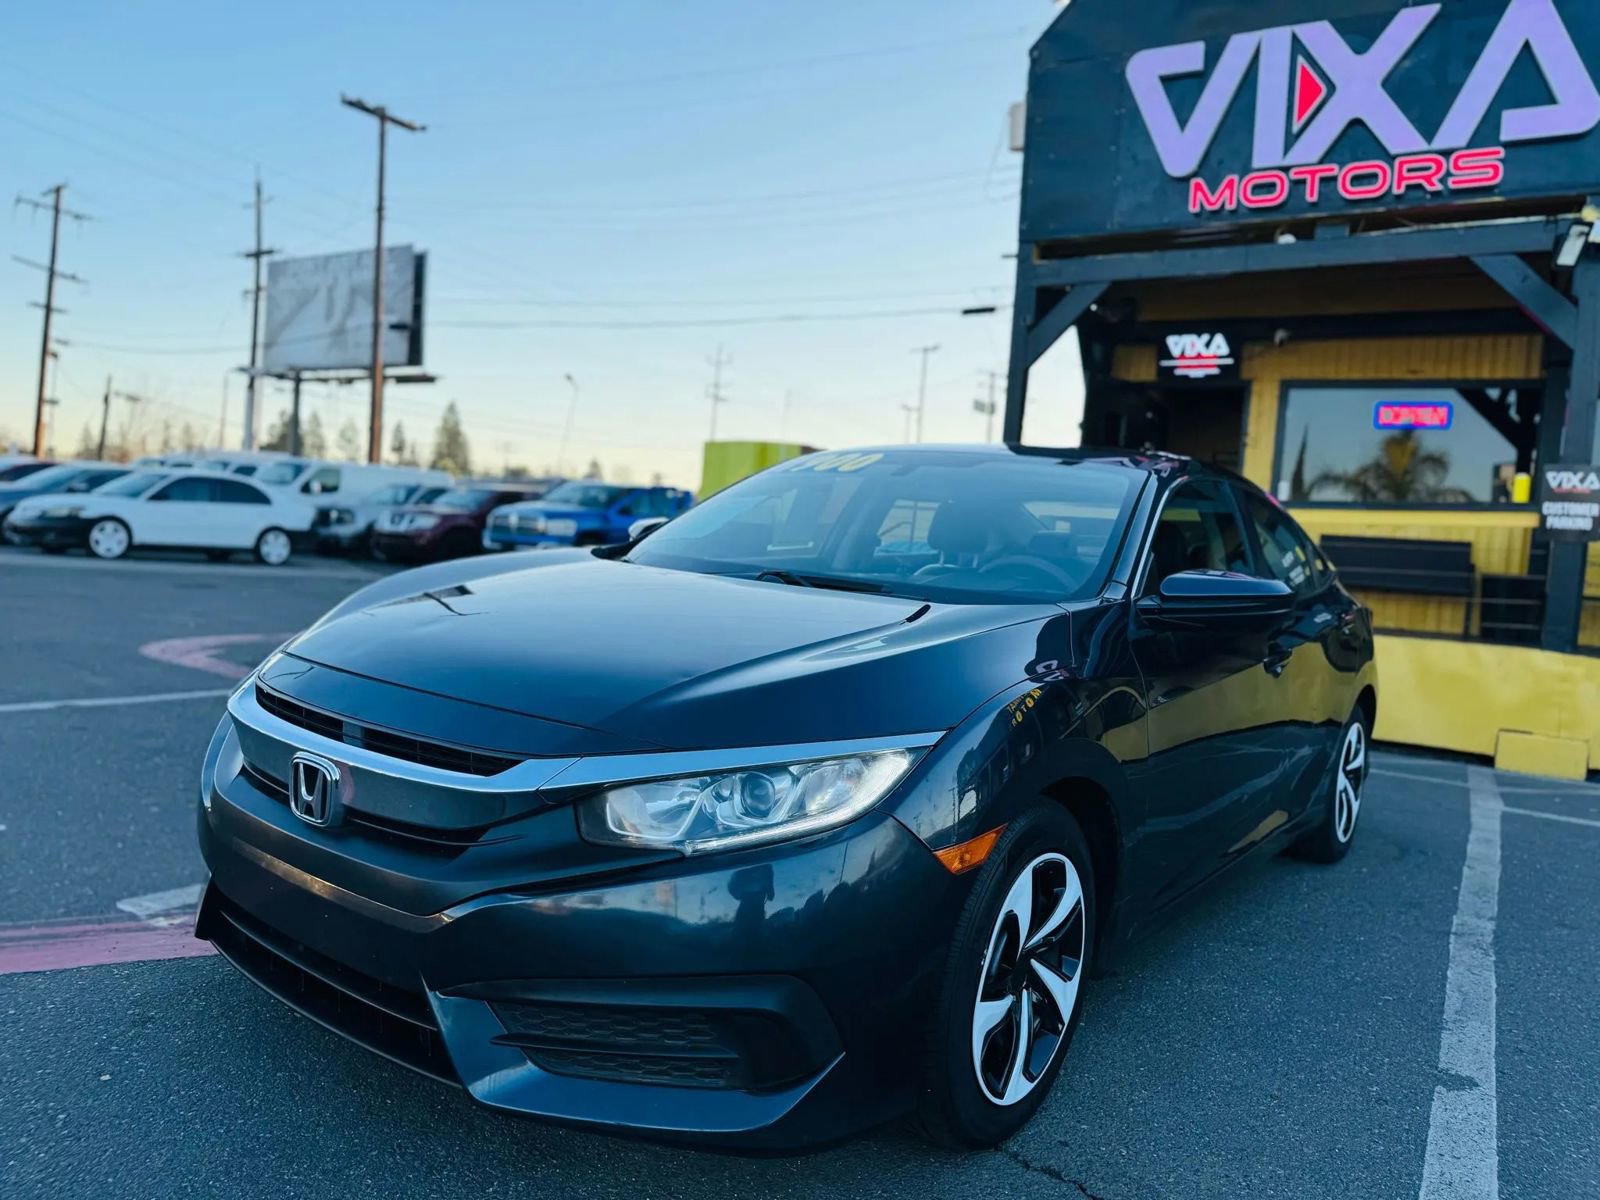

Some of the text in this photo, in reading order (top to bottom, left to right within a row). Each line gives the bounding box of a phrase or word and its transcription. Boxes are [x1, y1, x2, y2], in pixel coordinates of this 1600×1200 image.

[1125, 0, 1600, 178] VIXA
[1188, 147, 1506, 213] MOTORS
[1165, 333, 1230, 358] VIXA
[1545, 471, 1600, 491] VIXA
